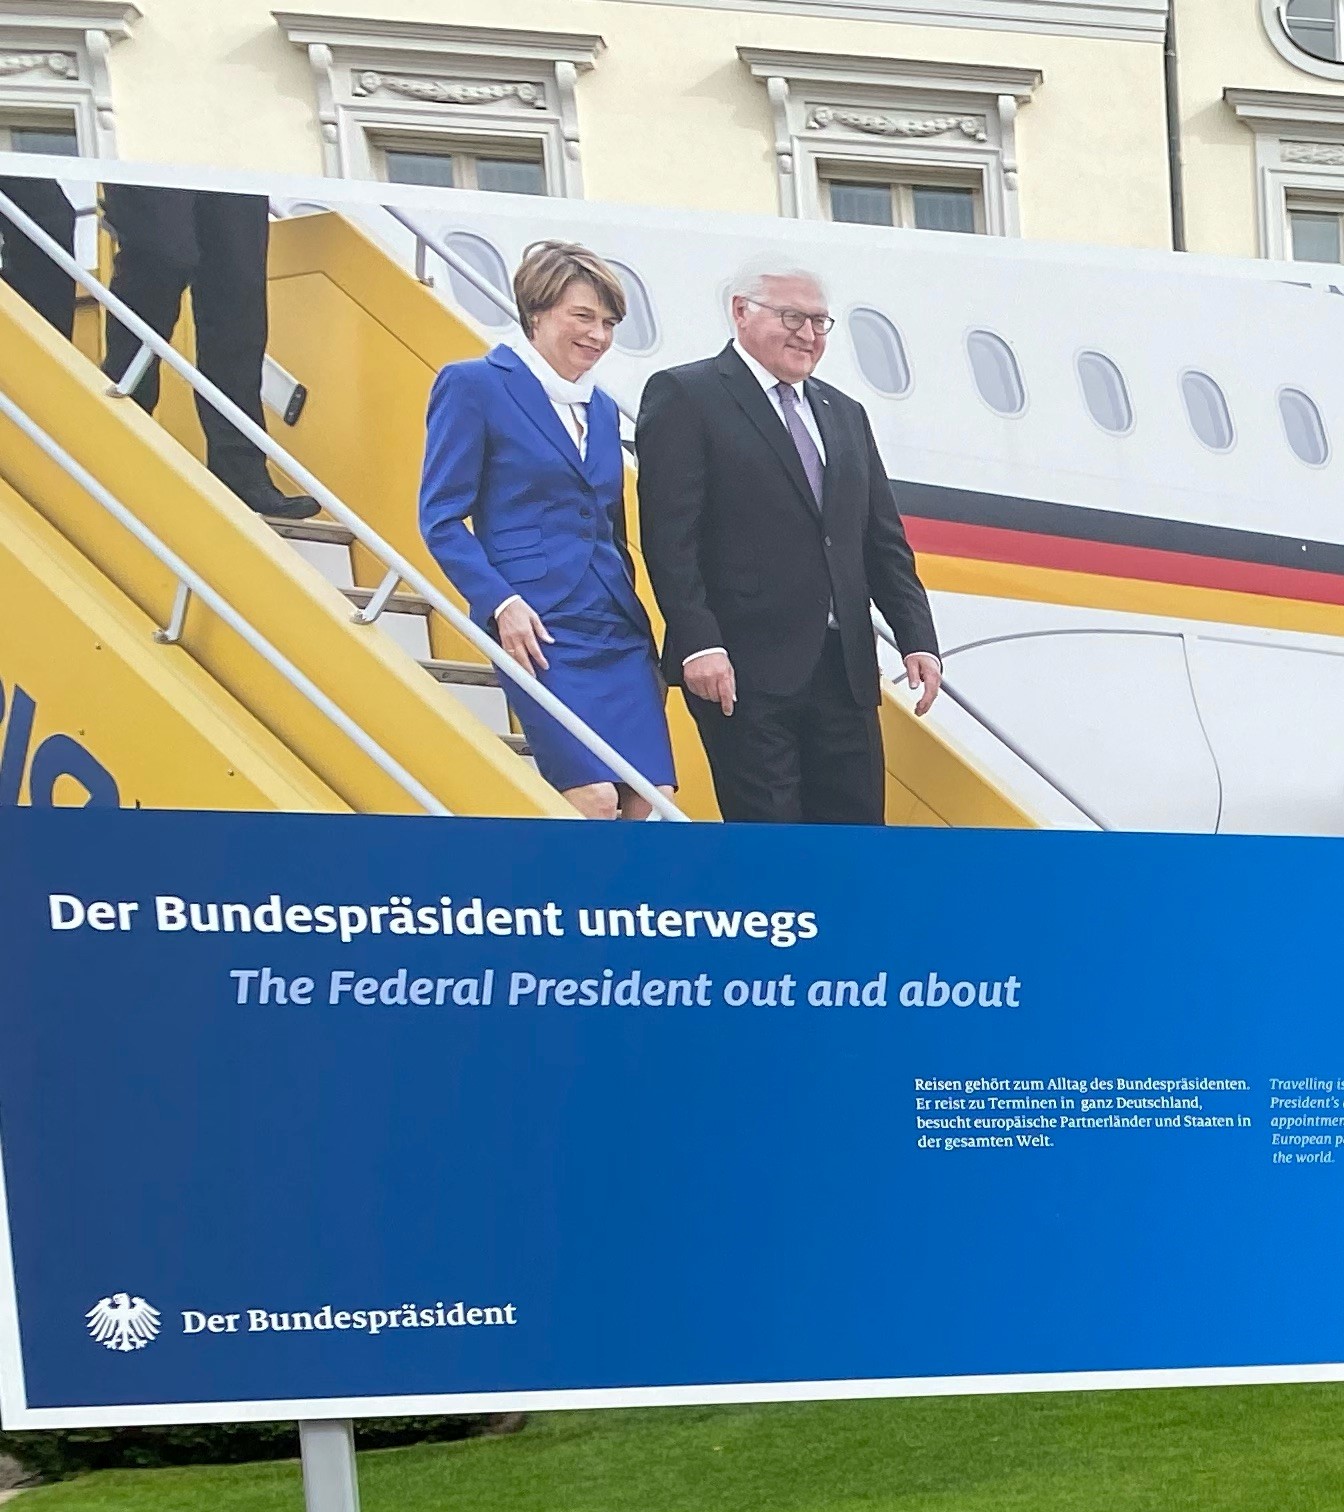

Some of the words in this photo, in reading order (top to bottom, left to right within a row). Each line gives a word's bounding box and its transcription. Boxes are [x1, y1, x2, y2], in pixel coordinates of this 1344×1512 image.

[49, 894, 139, 930] Der
[155, 894, 564, 942] Bundespräsident
[578, 903, 818, 947] unterwegs
[229, 967, 314, 1004] The
[328, 968, 493, 1005] Federal
[508, 968, 712, 1006] President
[723, 974, 796, 1006] out
[807, 971, 887, 1007] and
[899, 972, 1021, 1007] about
[915, 1077, 962, 1090] Reisen
[965, 1077, 1011, 1093] gehört
[1013, 1080, 1044, 1090] zum
[1047, 1077, 1088, 1093] Alltag
[1090, 1077, 1113, 1090] des
[1117, 1077, 1250, 1092] Bundespräsidenten.
[1268, 1077, 1333, 1092] Travelling
[916, 1097, 932, 1110] Er
[934, 1096, 966, 1109] reist
[968, 1099, 985, 1109] zu
[988, 1096, 1057, 1109] Terminen
[1060, 1099, 1074, 1108] in
[1081, 1099, 1114, 1112] ganz
[1116, 1096, 1202, 1110] Deutschland,
[916, 1115, 972, 1128] besucht
[974, 1115, 1057, 1131] europäische
[1060, 1115, 1152, 1128] Partnerländer
[1154, 1114, 1181, 1127] und
[1184, 1115, 1234, 1127] Staaten
[1237, 1114, 1251, 1127] in
[917, 1135, 942, 1148] der
[944, 1136, 1013, 1150] gesamten
[1016, 1134, 1054, 1146] Welt.
[1272, 1133, 1332, 1148] European
[1273, 1151, 1293, 1163] the
[1295, 1151, 1335, 1163] world.
[180, 1311, 240, 1333] Der
[246, 1301, 517, 1334] Bundespräsident
